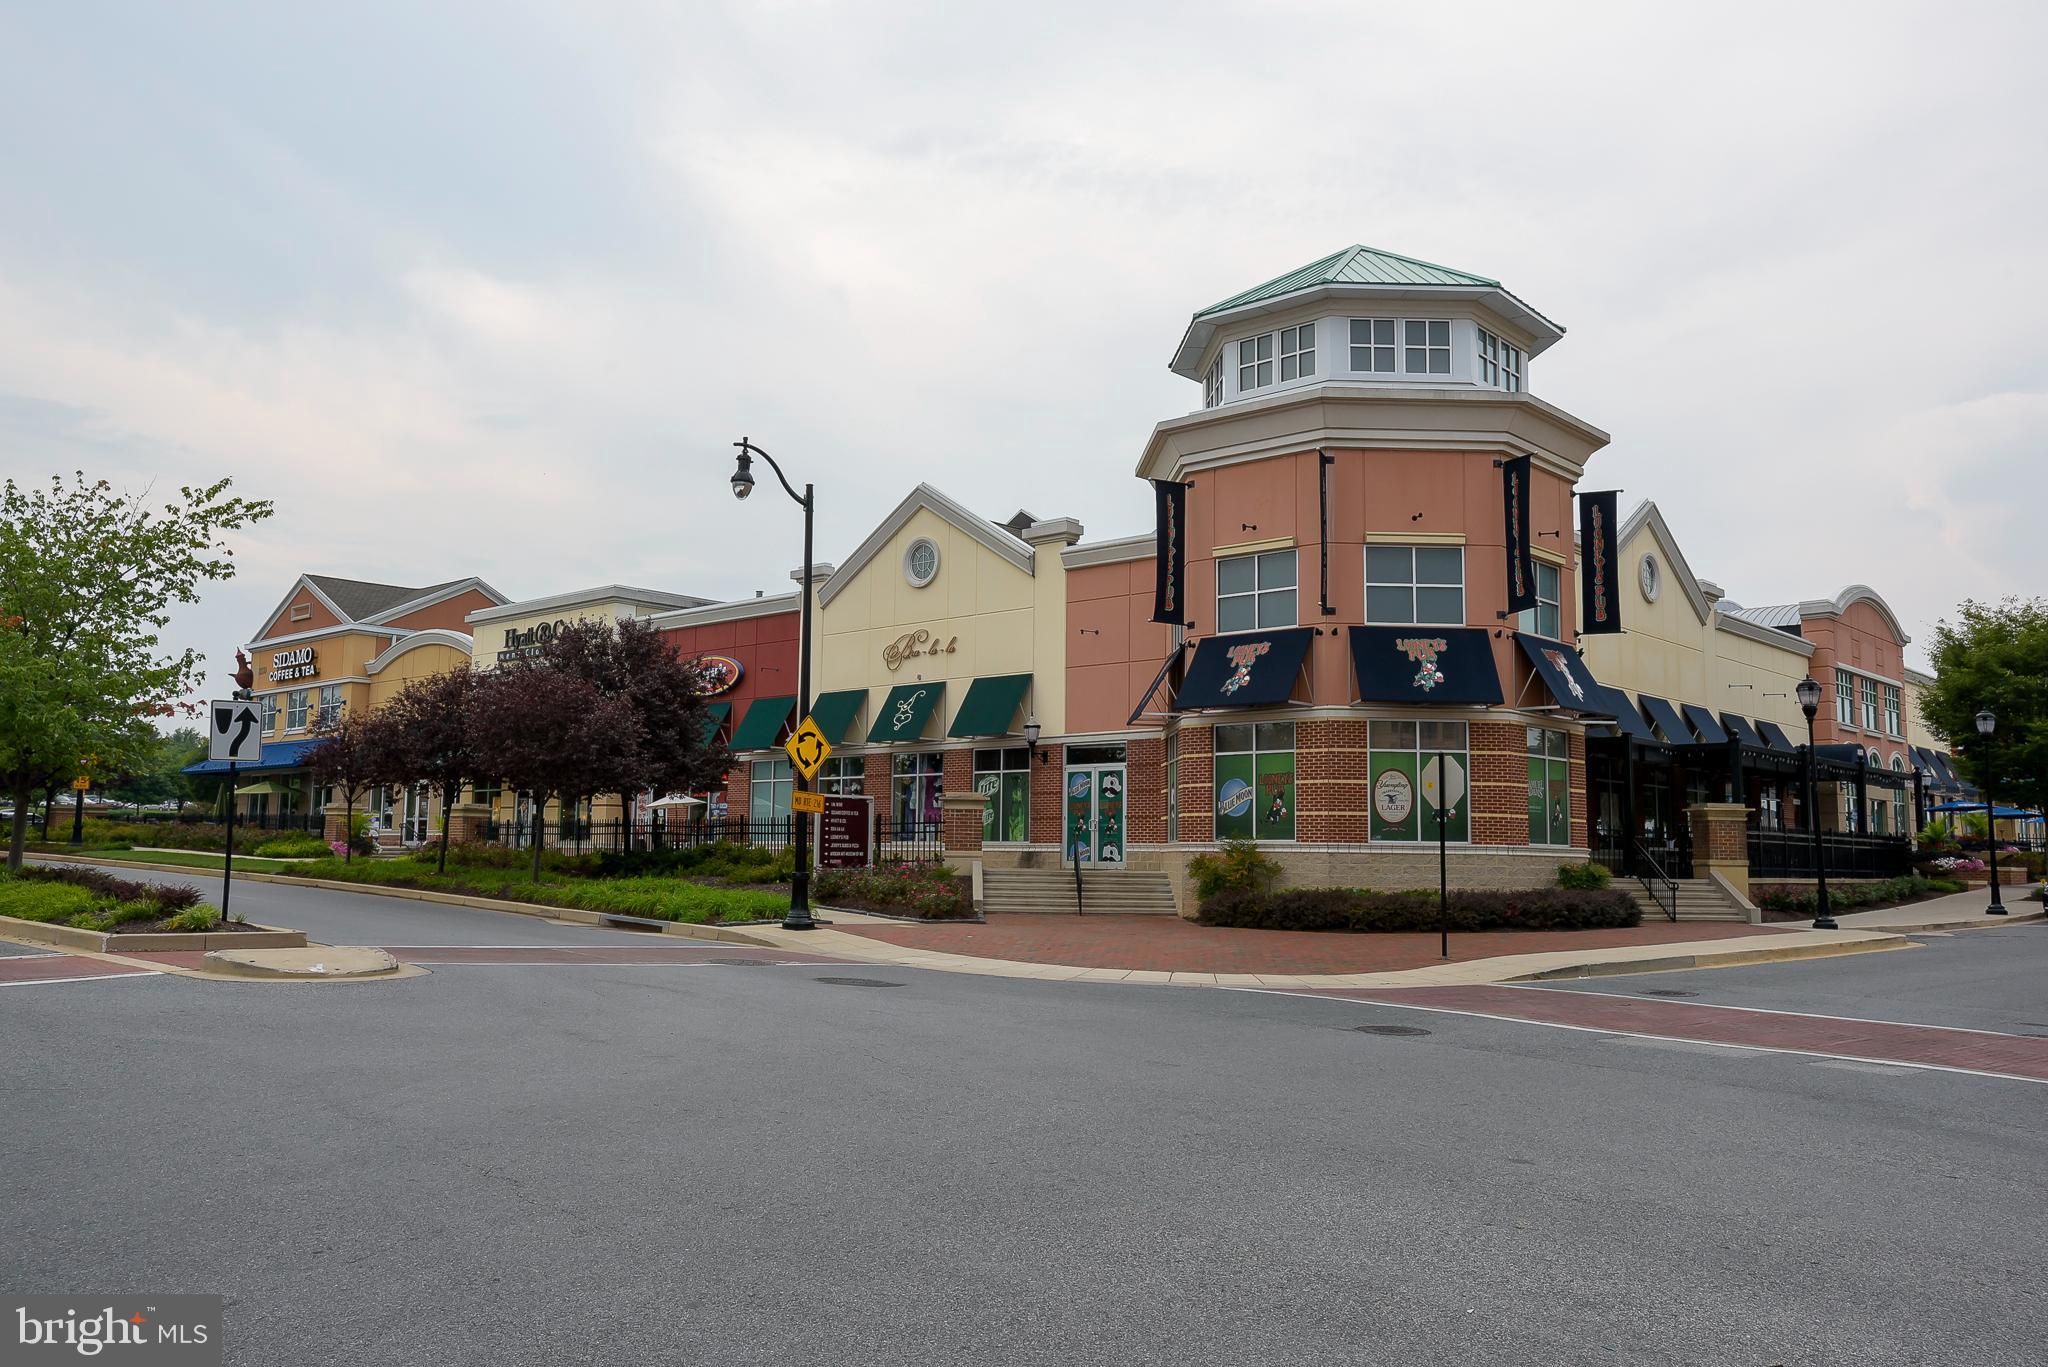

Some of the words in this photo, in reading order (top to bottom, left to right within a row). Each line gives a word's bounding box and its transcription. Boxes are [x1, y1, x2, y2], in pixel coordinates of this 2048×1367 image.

[1595, 584, 1607, 622] PUB
[504, 626, 537, 650] Hyatt
[273, 647, 312, 668] SIDAMO
[1408, 648, 1438, 661] PUB
[269, 669, 294, 682] COFFEE
[294, 667, 300, 678] &
[301, 664, 315, 677] TEA
[794, 796, 802, 805] MD
[803, 797, 812, 807] RTE
[813, 798, 822, 808] 216
[1218, 796, 1237, 816] BLUE
[1236, 786, 1253, 804] MOON
